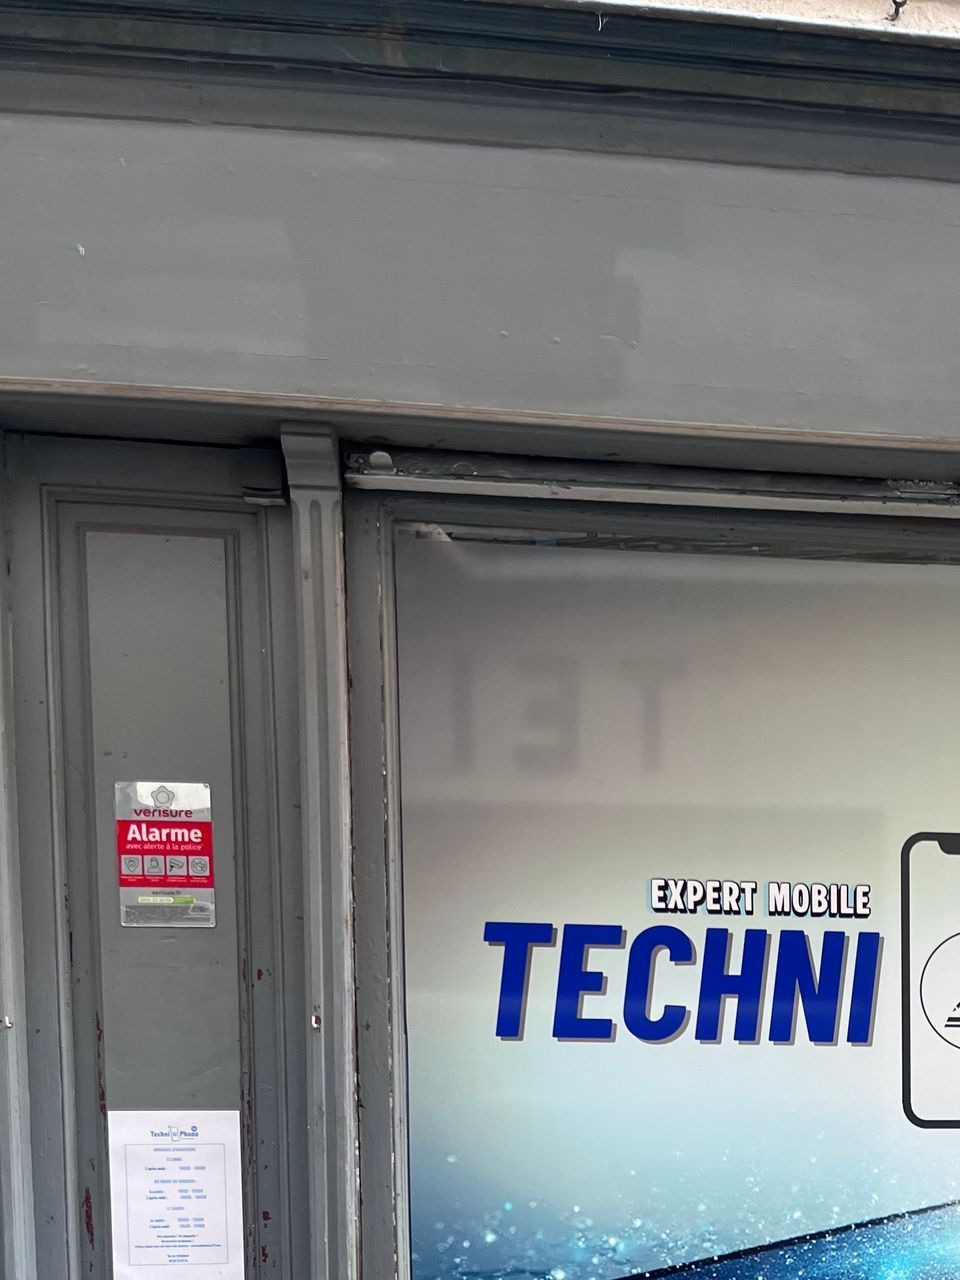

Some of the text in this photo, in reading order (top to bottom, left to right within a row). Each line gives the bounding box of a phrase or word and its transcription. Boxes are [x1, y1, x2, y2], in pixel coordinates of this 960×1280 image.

[133, 808, 193, 818] verisure
[127, 823, 203, 842] Alarme
[143, 842, 164, 850] alerte
[166, 842, 171, 850] à
[172, 843, 179, 851] la
[650, 878, 871, 918] EXPERT MOBILE
[483, 921, 885, 1047] TECHNI
